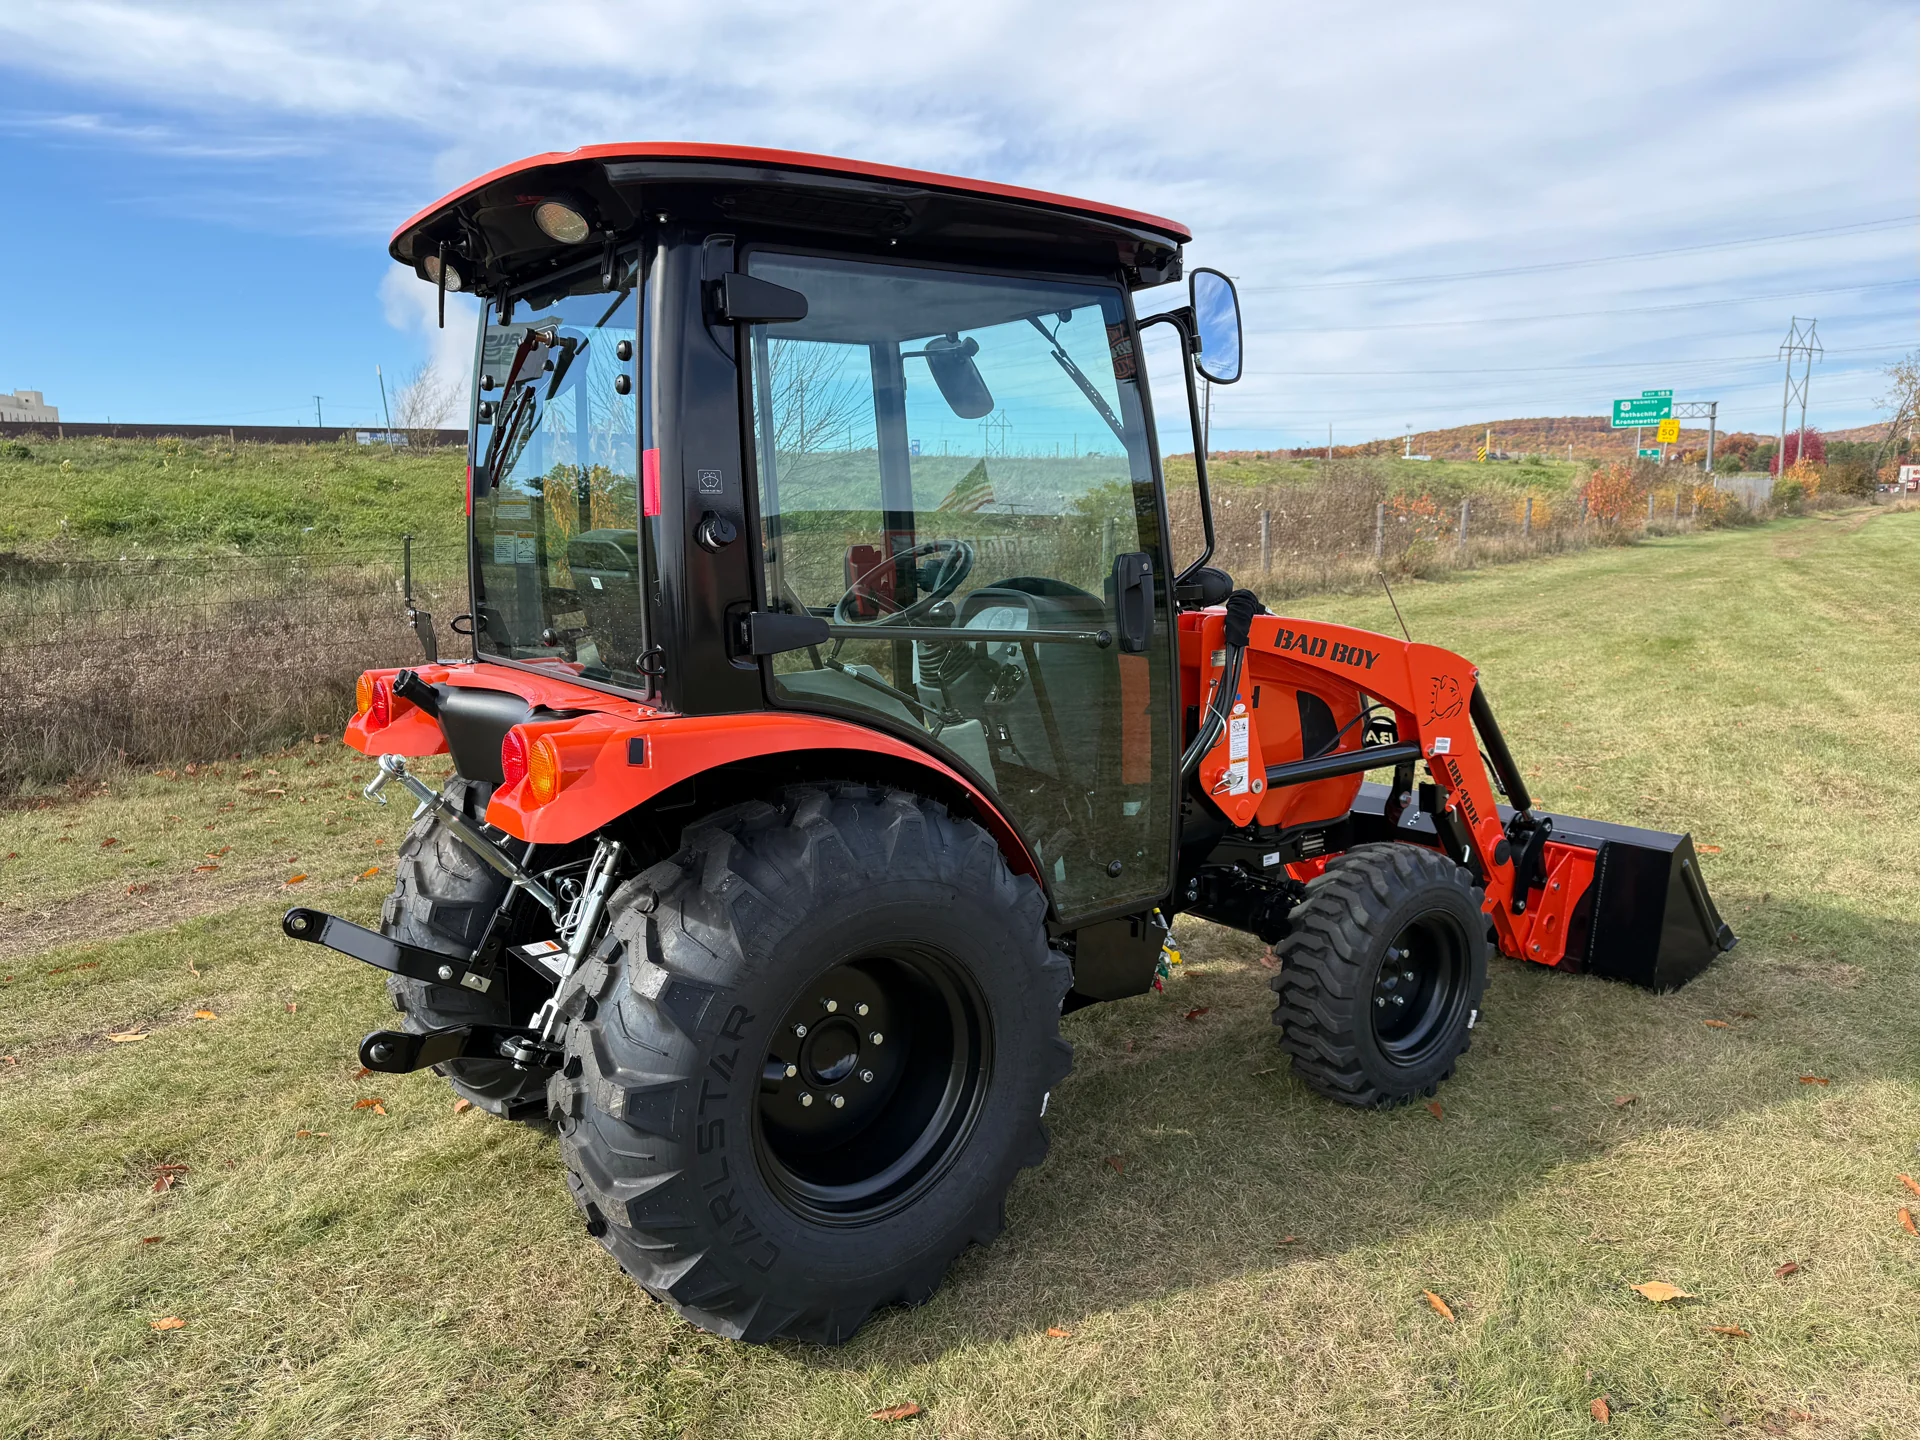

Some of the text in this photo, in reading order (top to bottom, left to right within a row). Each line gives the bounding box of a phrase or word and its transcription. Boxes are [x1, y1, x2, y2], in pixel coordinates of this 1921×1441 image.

[1661, 428, 1675, 436] 50
[1273, 628, 1380, 670] BAD BOY
[696, 1004, 780, 1274] CARLSTAR
